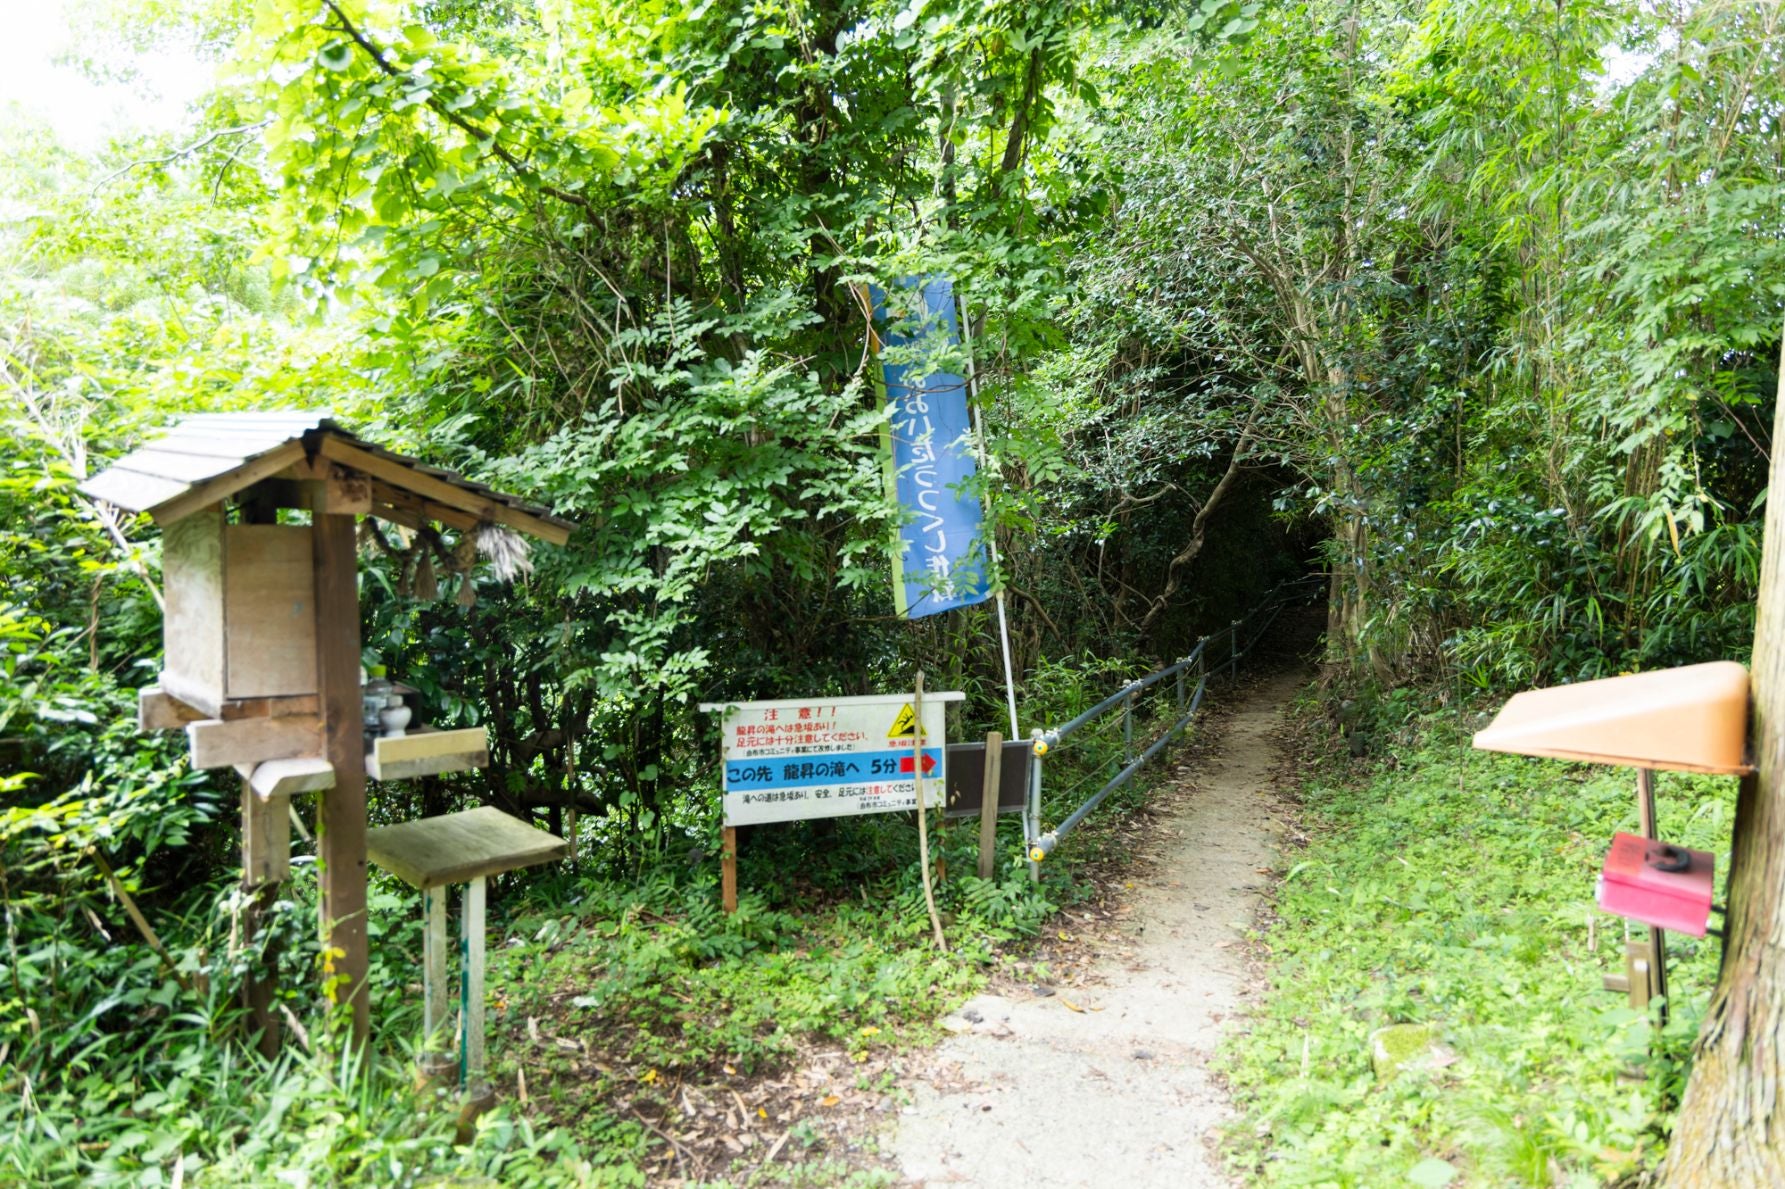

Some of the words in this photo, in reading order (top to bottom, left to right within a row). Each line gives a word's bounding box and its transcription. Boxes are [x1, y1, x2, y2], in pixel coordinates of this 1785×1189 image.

[727, 766, 773, 783] この先
[784, 760, 860, 781] 龍昇の滝へ
[871, 757, 897, 775] 5分
